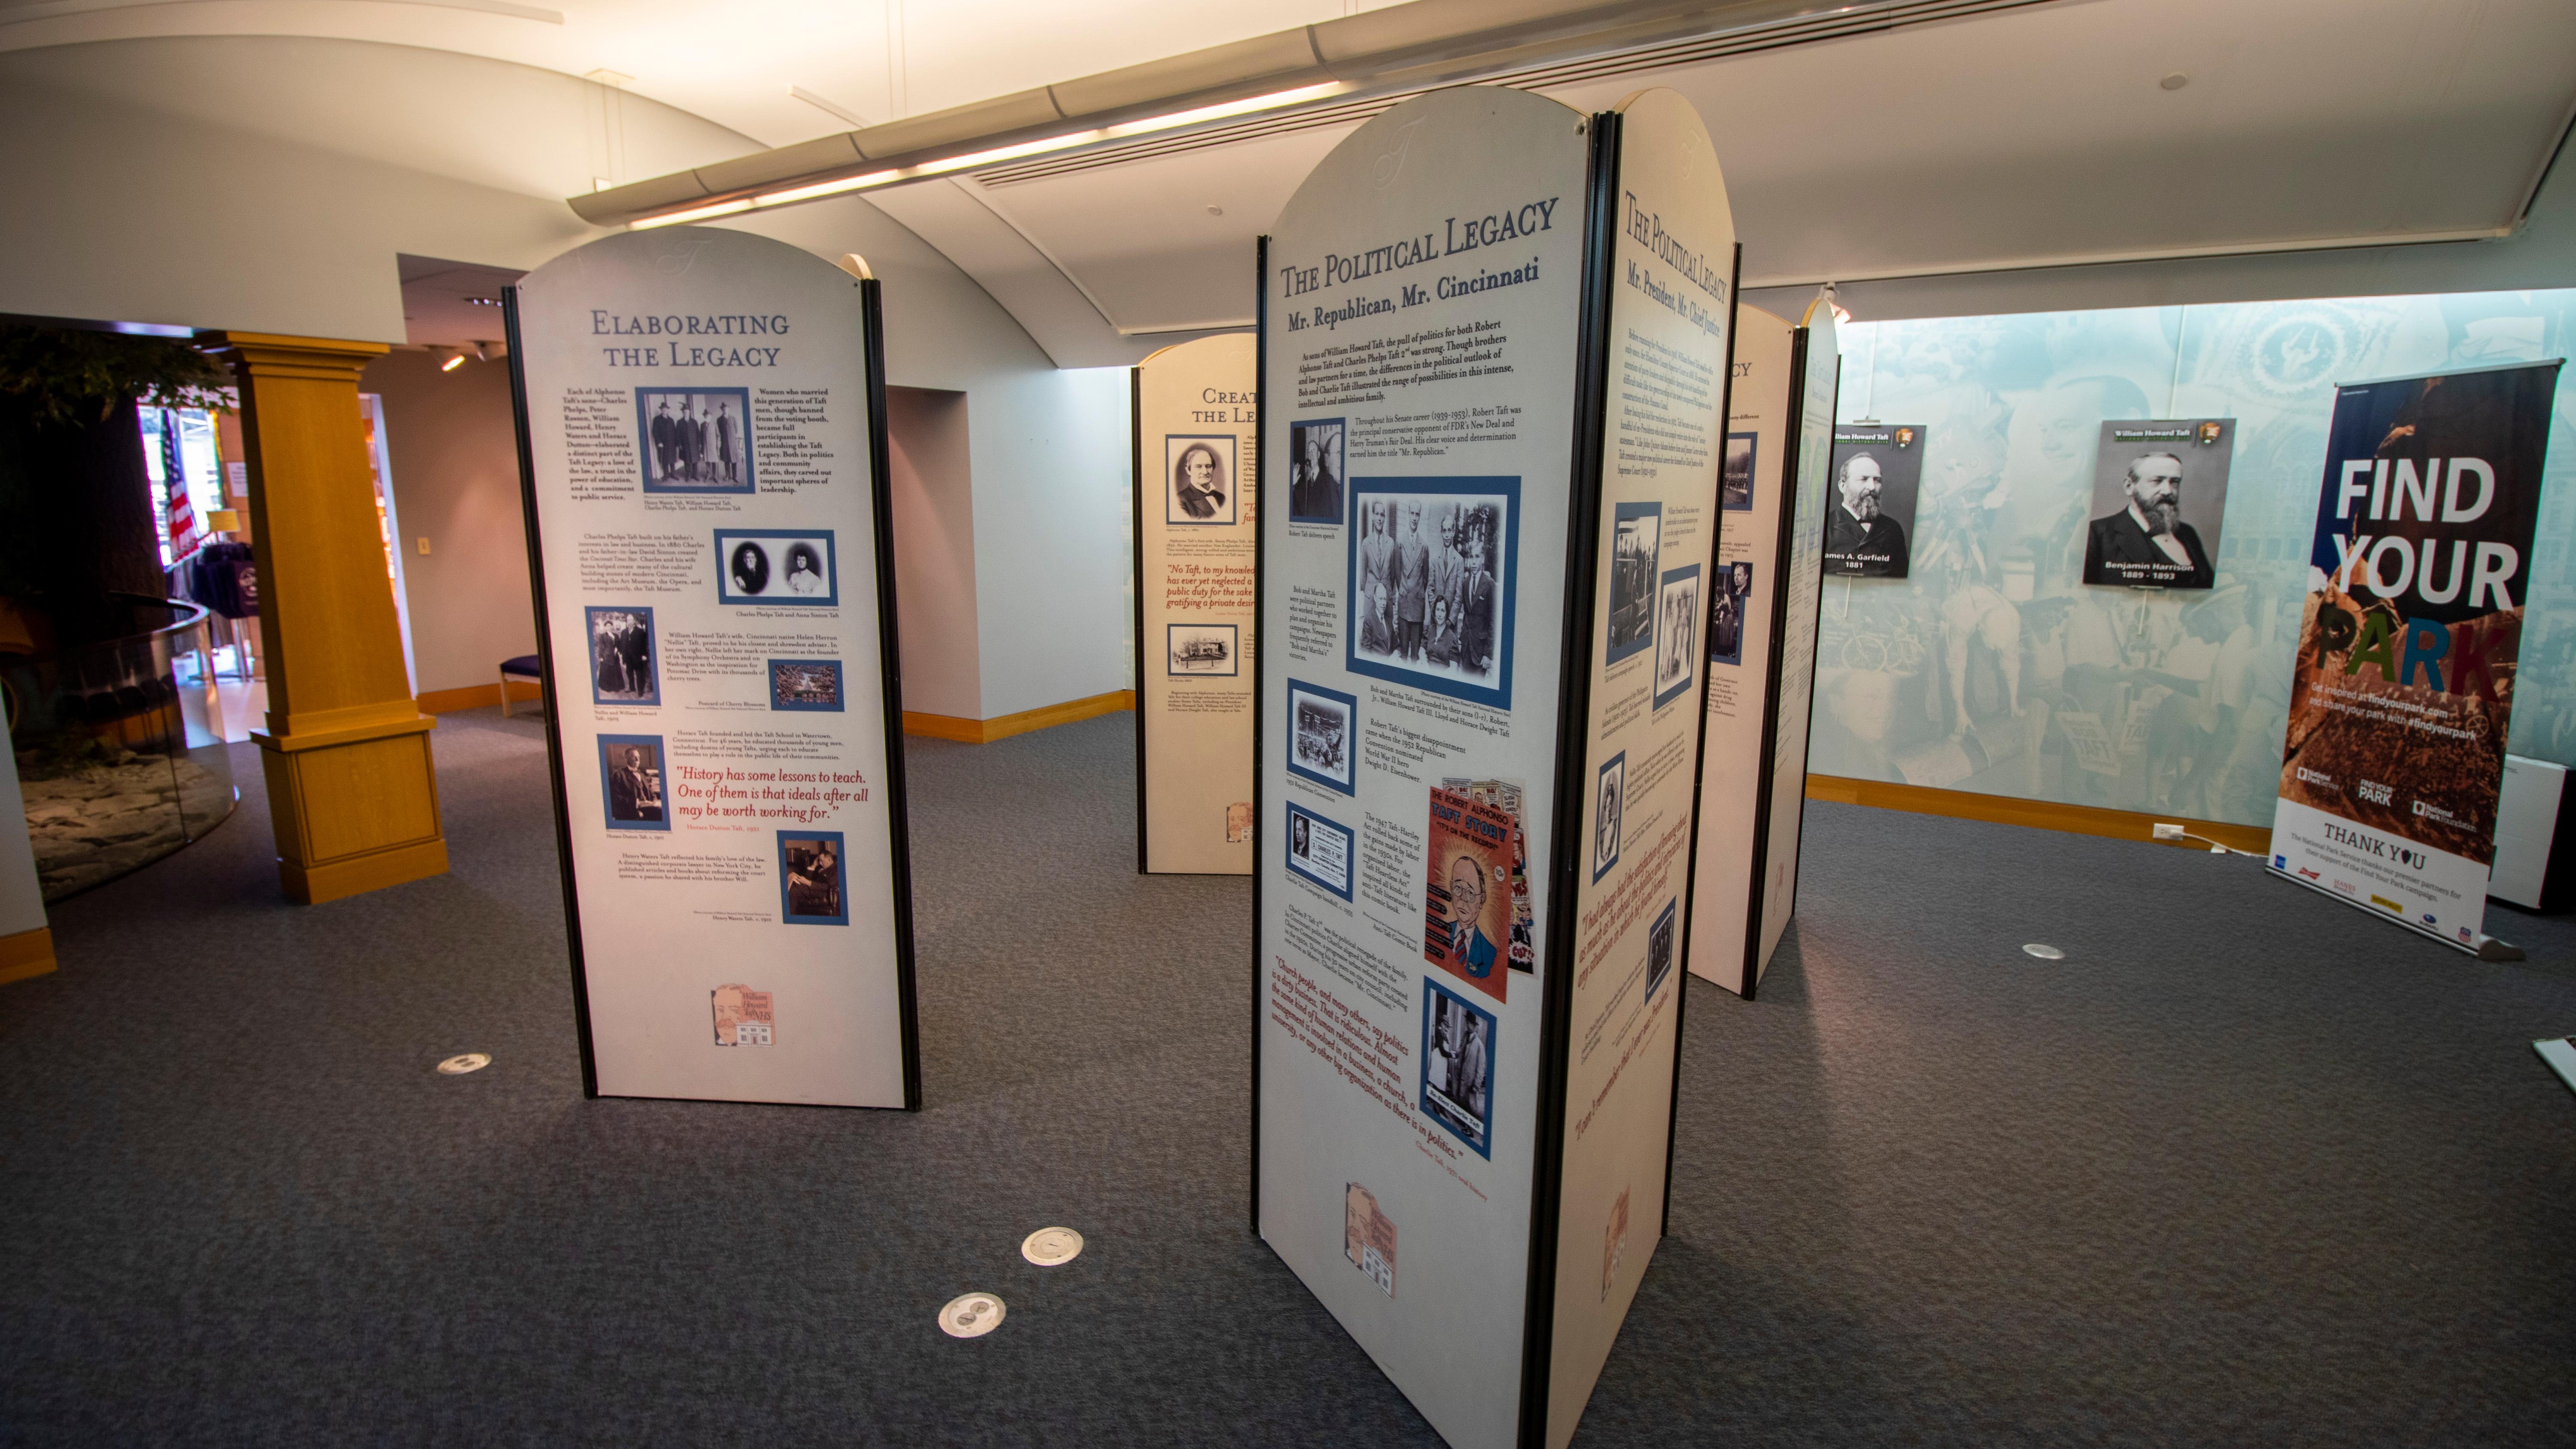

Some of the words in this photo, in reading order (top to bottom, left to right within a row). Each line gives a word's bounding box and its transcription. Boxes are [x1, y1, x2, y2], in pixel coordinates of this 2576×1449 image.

[1281, 266, 1318, 297] THE
[1324, 234, 1438, 287] POLITICAL
[1444, 197, 1559, 256] LEGACY
[1626, 190, 1649, 247] THE
[1651, 213, 1697, 284] POLITICAL
[1699, 254, 1726, 304] LEGACY
[1288, 312, 1309, 332] Mr.
[1314, 297, 1396, 330] Republican,
[1401, 284, 1430, 308] Mr.
[1437, 256, 1539, 300] Cincinnati
[1627, 258, 1641, 290] Mr.
[1644, 270, 1675, 315] President,
[1678, 292, 1688, 318] Mr.
[1690, 301, 1704, 327] Chief
[1703, 309, 1719, 338] Justice
[591, 310, 790, 335] ELABORATING
[1327, 347, 1348, 356] William
[1349, 342, 1370, 353] Howard
[1372, 340, 1385, 349] Taft,
[1387, 338, 1395, 347] the
[1397, 335, 1410, 348] pull
[1412, 333, 1419, 342] of
[1420, 330, 1443, 344] politics
[1445, 327, 1455, 337] for
[1457, 324, 1473, 335] both
[1475, 321, 1501, 332] Robert
[603, 349, 659, 366] THE
[668, 342, 781, 367] LEGACY
[769, 398, 804, 406] generation
[775, 406, 797, 415] though
[786, 416, 806, 424] voting
[1192, 411, 1226, 422] THE
[1233, 408, 1255, 422] LE
[1413, 446, 1449, 458] Republican."
[2336, 457, 2495, 523] FIND
[1168, 565, 1183, 573] "No
[1185, 565, 1201, 576] Taft,
[2105, 561, 2150, 570] Benjamin
[2153, 563, 2194, 571] Harrison
[2333, 534, 2518, 611] YOUR
[1166, 587, 1190, 597] public
[1192, 586, 1208, 598] duty
[1209, 587, 1221, 598] for
[1167, 576, 1179, 584] has
[1197, 578, 1209, 587] yet
[1212, 576, 1245, 587] neglected
[1166, 598, 1202, 609] gratifying
[1209, 599, 1235, 609] private
[2317, 603, 2508, 702] PARK
[2311, 682, 2323, 691] Get
[2325, 685, 2357, 700] inspired
[2358, 693, 2367, 701] at
[2368, 694, 2448, 718] findyourpark.com
[2309, 696, 2322, 706] and
[2323, 699, 2345, 711] share
[2345, 706, 2364, 716] your
[2366, 709, 2385, 720] park
[2387, 713, 2406, 724] with
[2408, 719, 2476, 741] #findyourpark
[1370, 718, 1387, 729] Robert
[1388, 723, 1402, 734] Taft's
[1403, 728, 1420, 740] biggest
[1422, 734, 1465, 754] disappointment
[1379, 733, 1391, 741] when
[1402, 740, 1414, 749] 1952
[1416, 743, 1446, 758] Republican
[677, 766, 723, 783] "History
[727, 767, 744, 780] has
[748, 773, 775, 781] some
[779, 769, 816, 782] lessons
[819, 772, 830, 782] to
[833, 770, 866, 783] teach.
[2361, 779, 2375, 788] FIND
[2376, 783, 2393, 793] YOUR
[678, 784, 702, 797] One
[705, 785, 719, 800] of
[720, 785, 747, 798] them
[751, 788, 759, 799] is
[762, 786, 785, 799] that
[789, 787, 820, 800] ideals
[824, 788, 851, 804] after
[854, 789, 868, 801] all
[2358, 786, 2391, 806] PARK
[679, 807, 702, 820] may
[707, 803, 718, 815] be
[723, 804, 756, 816] worth
[760, 805, 807, 822] working
[808, 806, 839, 823] for."
[1432, 789, 1442, 800] THE
[1445, 794, 1468, 809] ROBERT
[1471, 805, 1509, 825] ALPHONSO
[1431, 802, 1460, 824] TAFT
[1466, 815, 1507, 842] STORY
[2324, 823, 2385, 857] THANK
